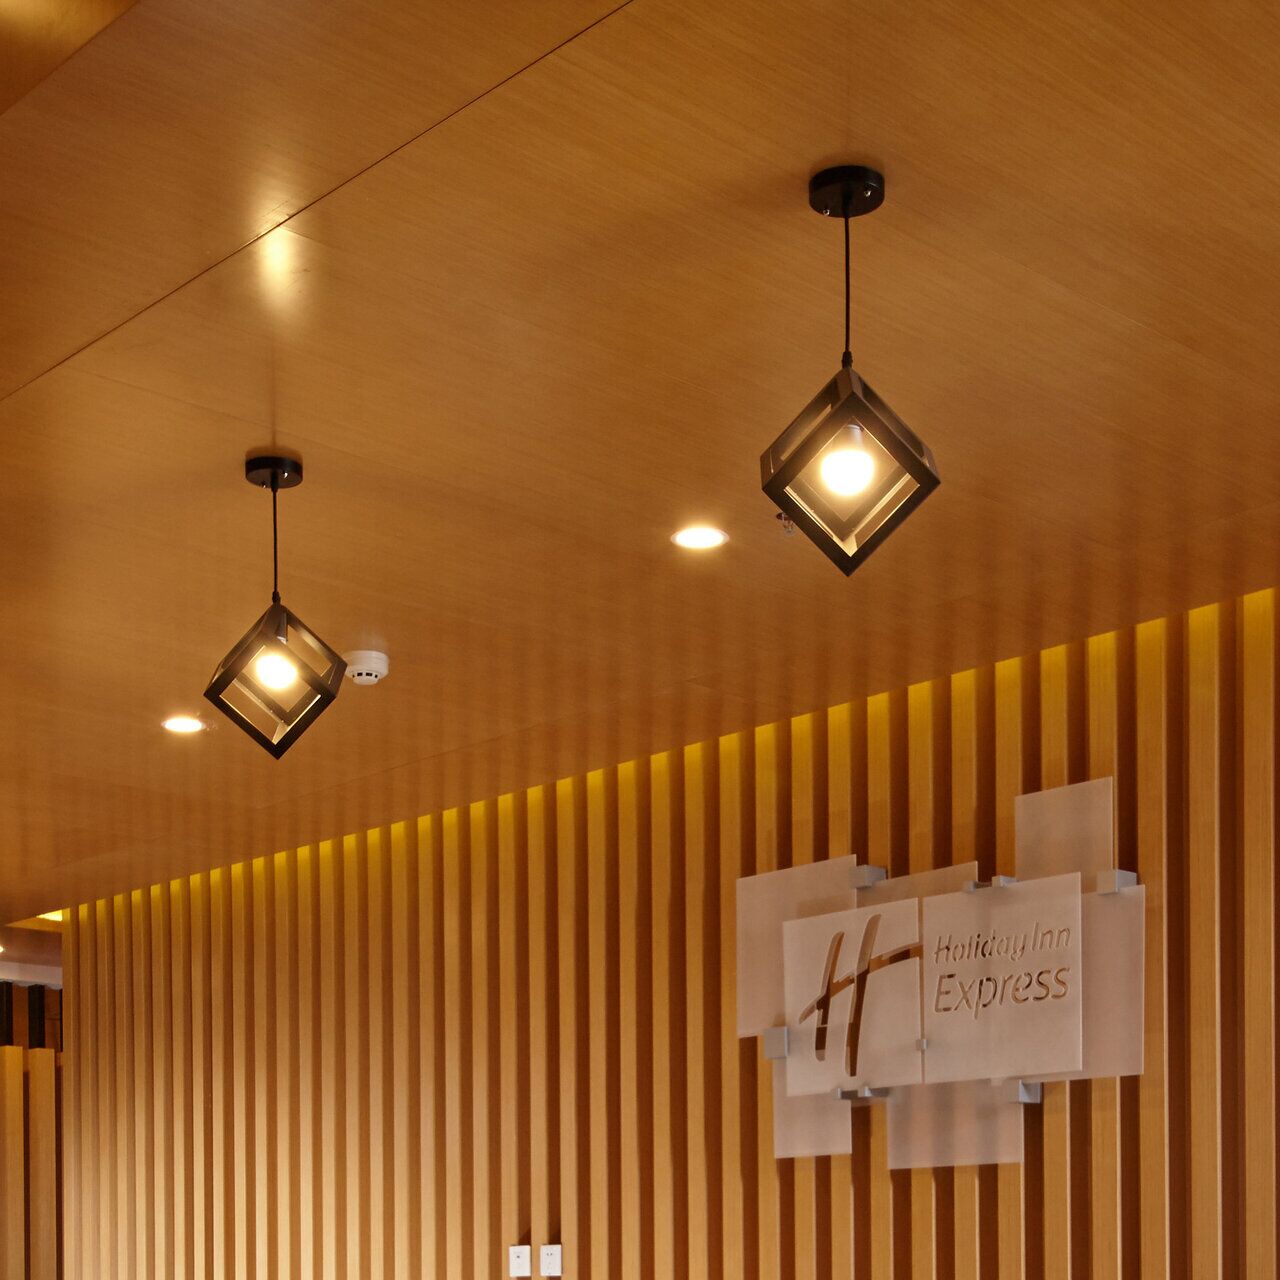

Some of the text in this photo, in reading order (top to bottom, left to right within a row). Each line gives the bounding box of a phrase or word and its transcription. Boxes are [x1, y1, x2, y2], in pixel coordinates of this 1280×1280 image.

[934, 920, 1071, 964] Holiday Inn
[934, 966, 1071, 1020] Express
